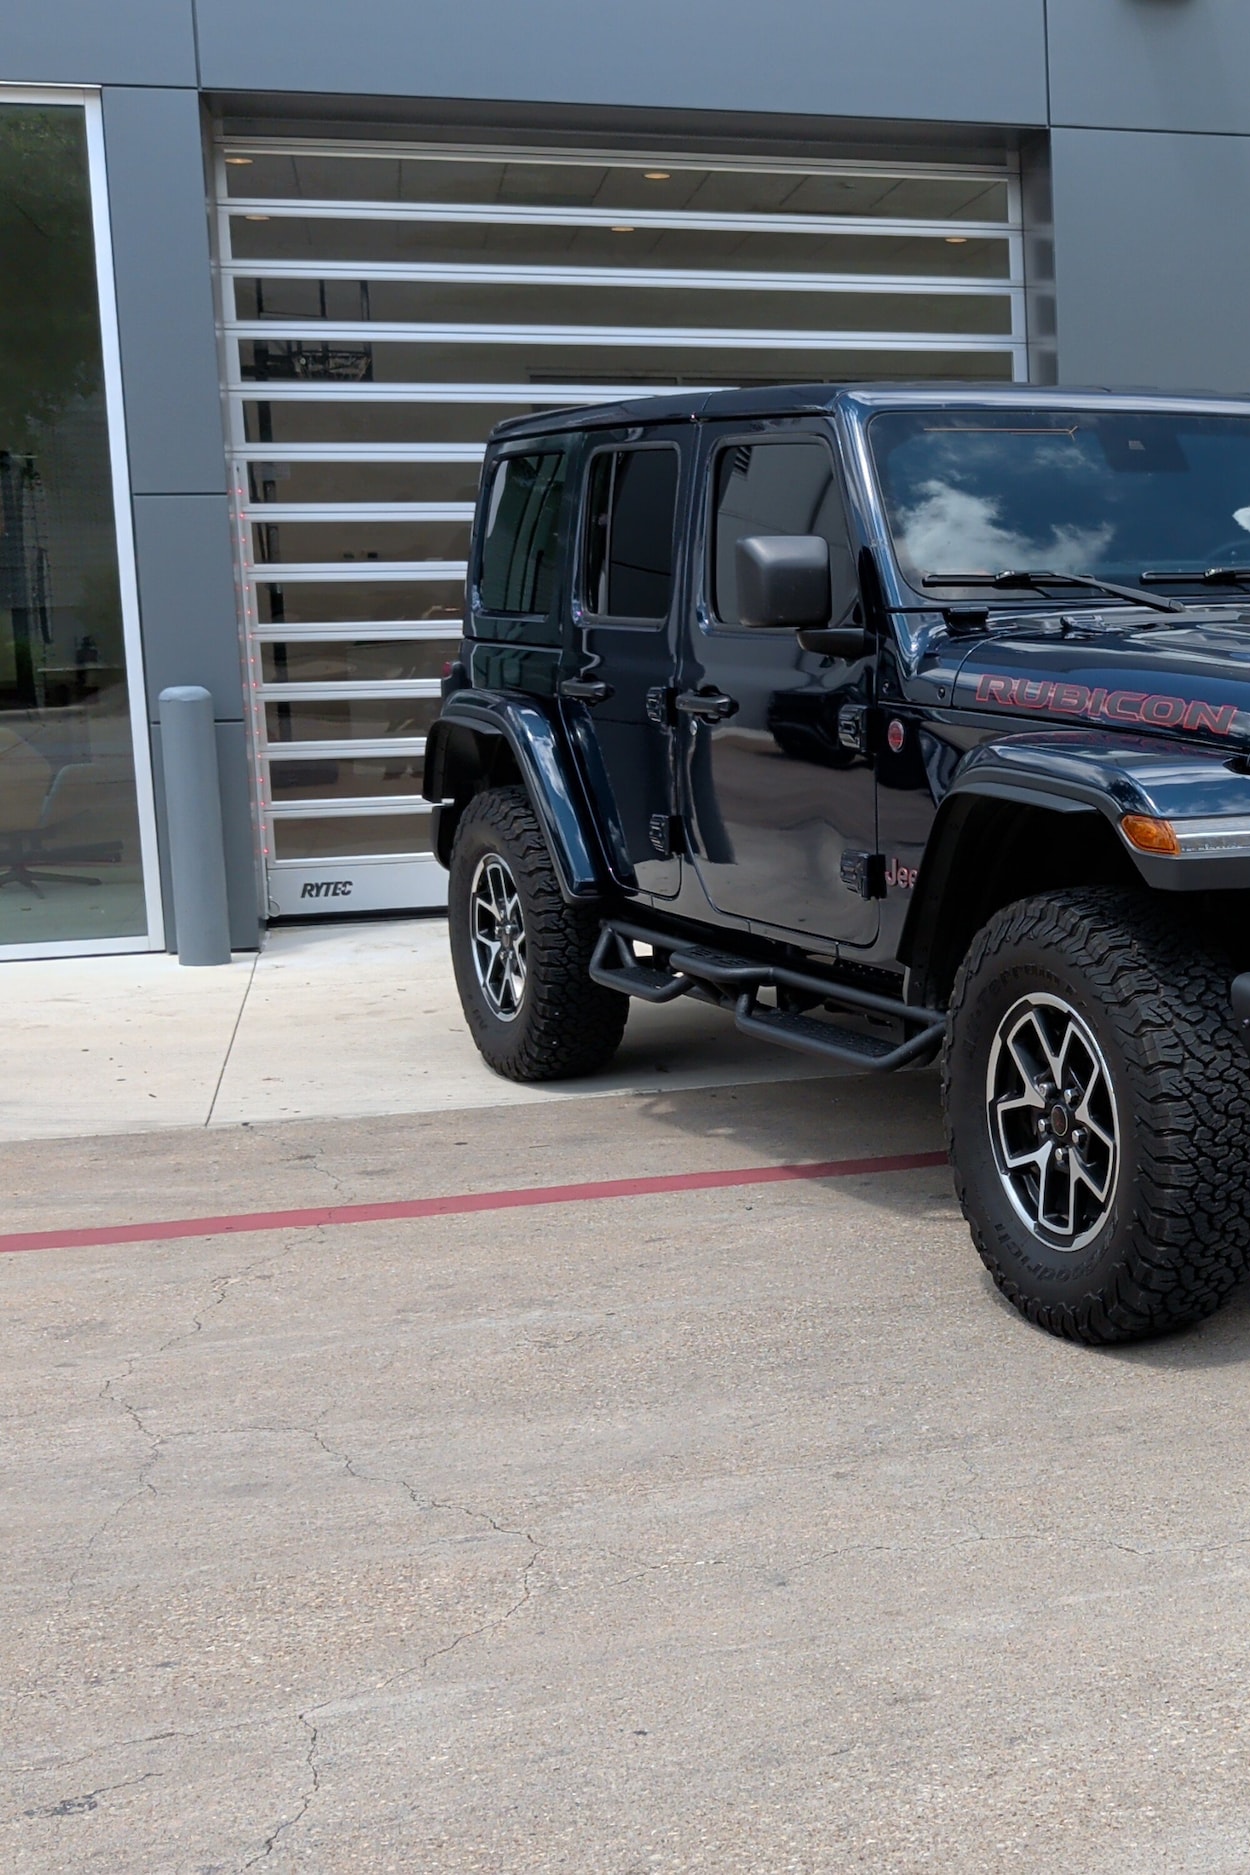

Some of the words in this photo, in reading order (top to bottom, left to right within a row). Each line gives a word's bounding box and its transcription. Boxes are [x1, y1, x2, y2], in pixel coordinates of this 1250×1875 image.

[976, 674, 1238, 735] RUBICON
[885, 858, 918, 888] Jee
[301, 881, 353, 898] RYTEC
